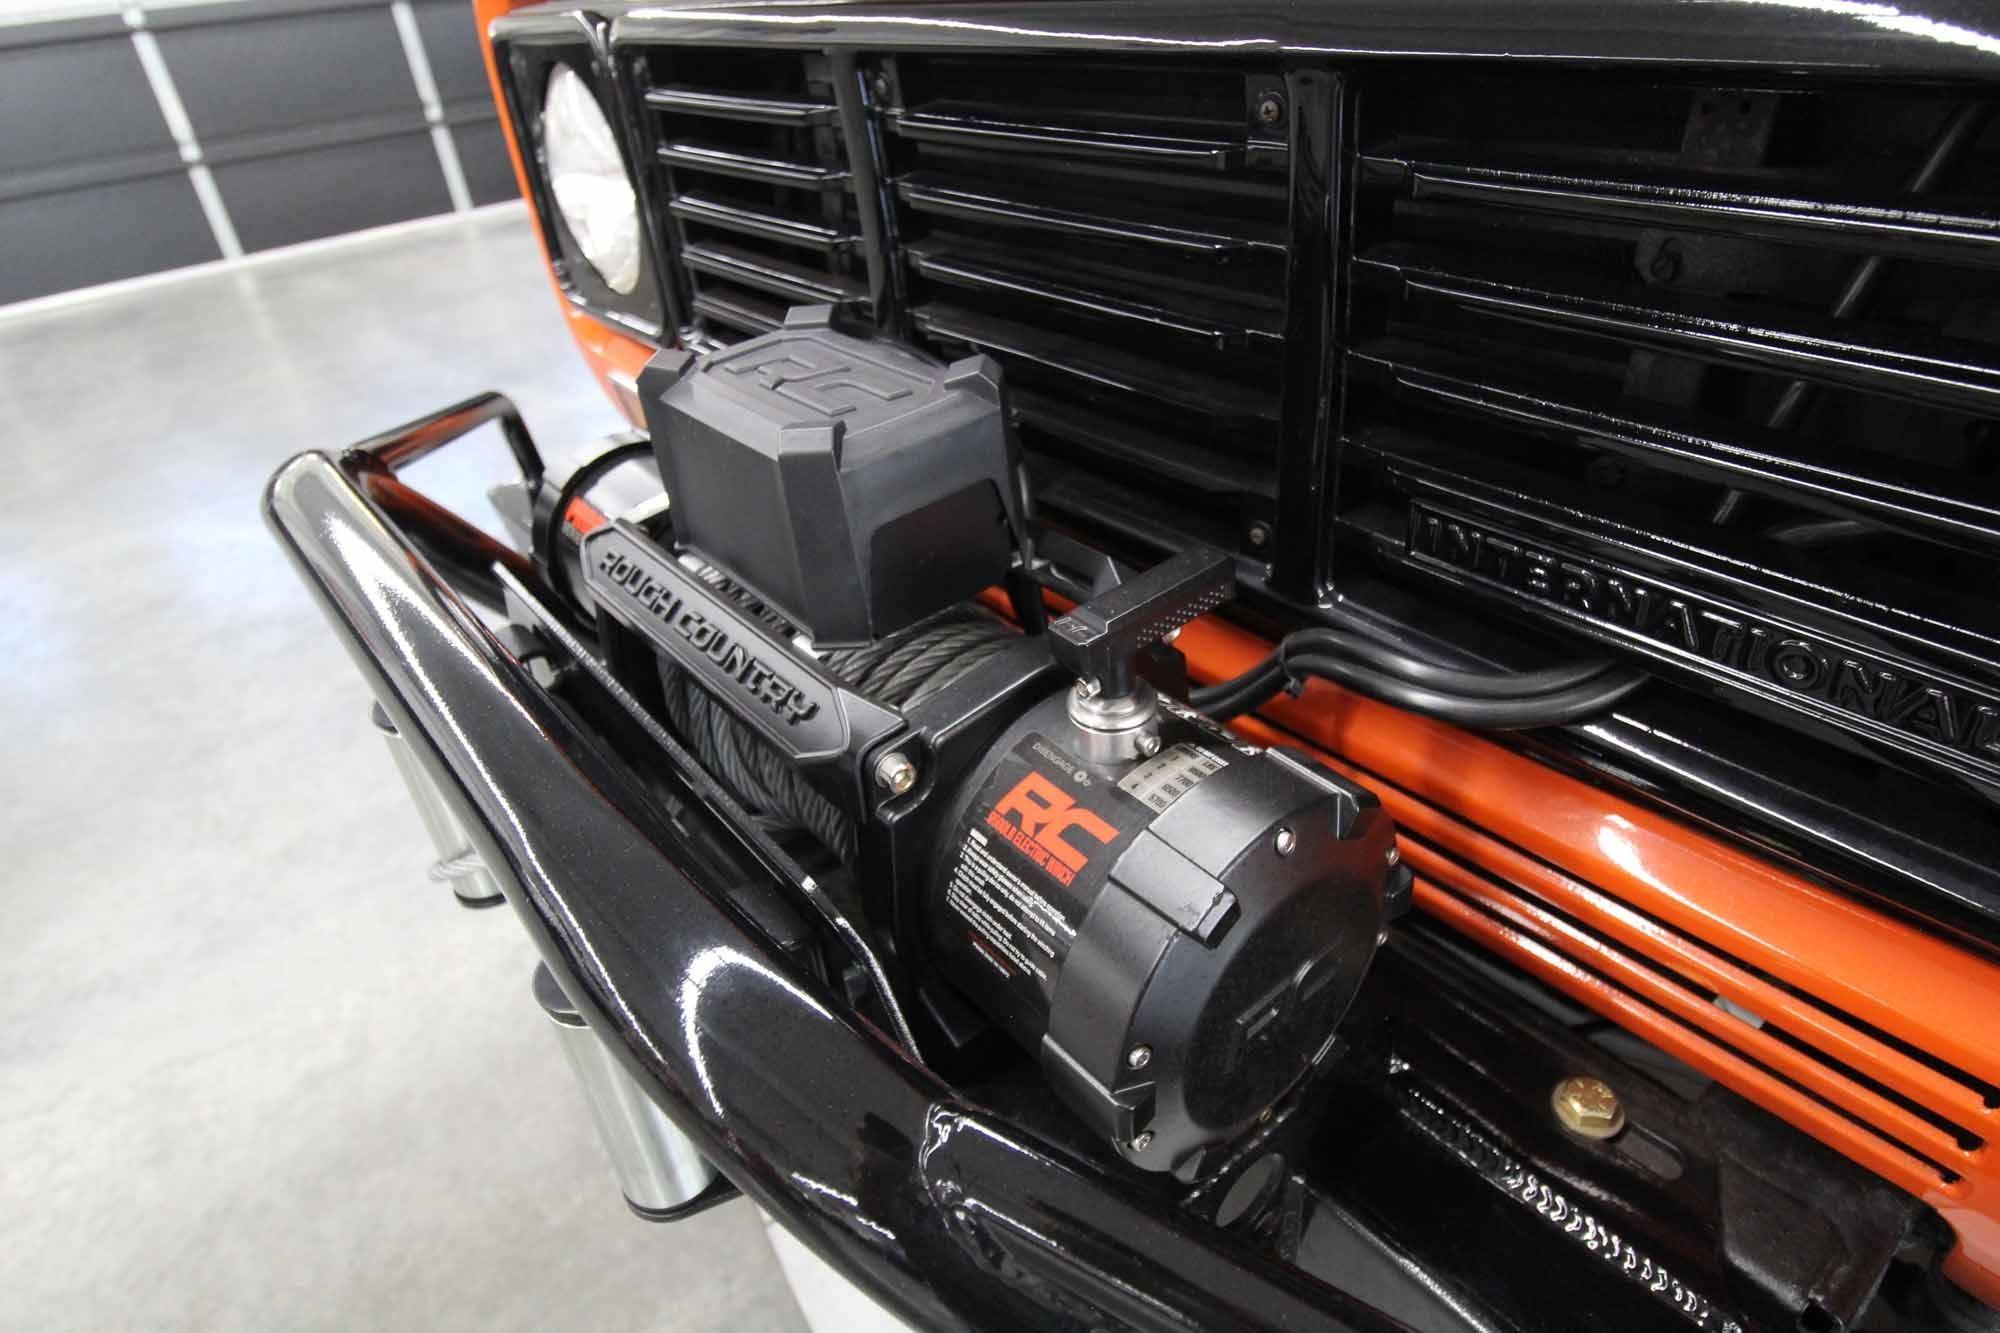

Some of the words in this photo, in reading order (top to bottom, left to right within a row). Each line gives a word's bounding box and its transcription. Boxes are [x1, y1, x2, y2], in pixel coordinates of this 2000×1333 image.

[598, 552, 683, 625] ROUGH
[673, 610, 821, 727] COUNTRY
[994, 771, 1120, 873] RC
